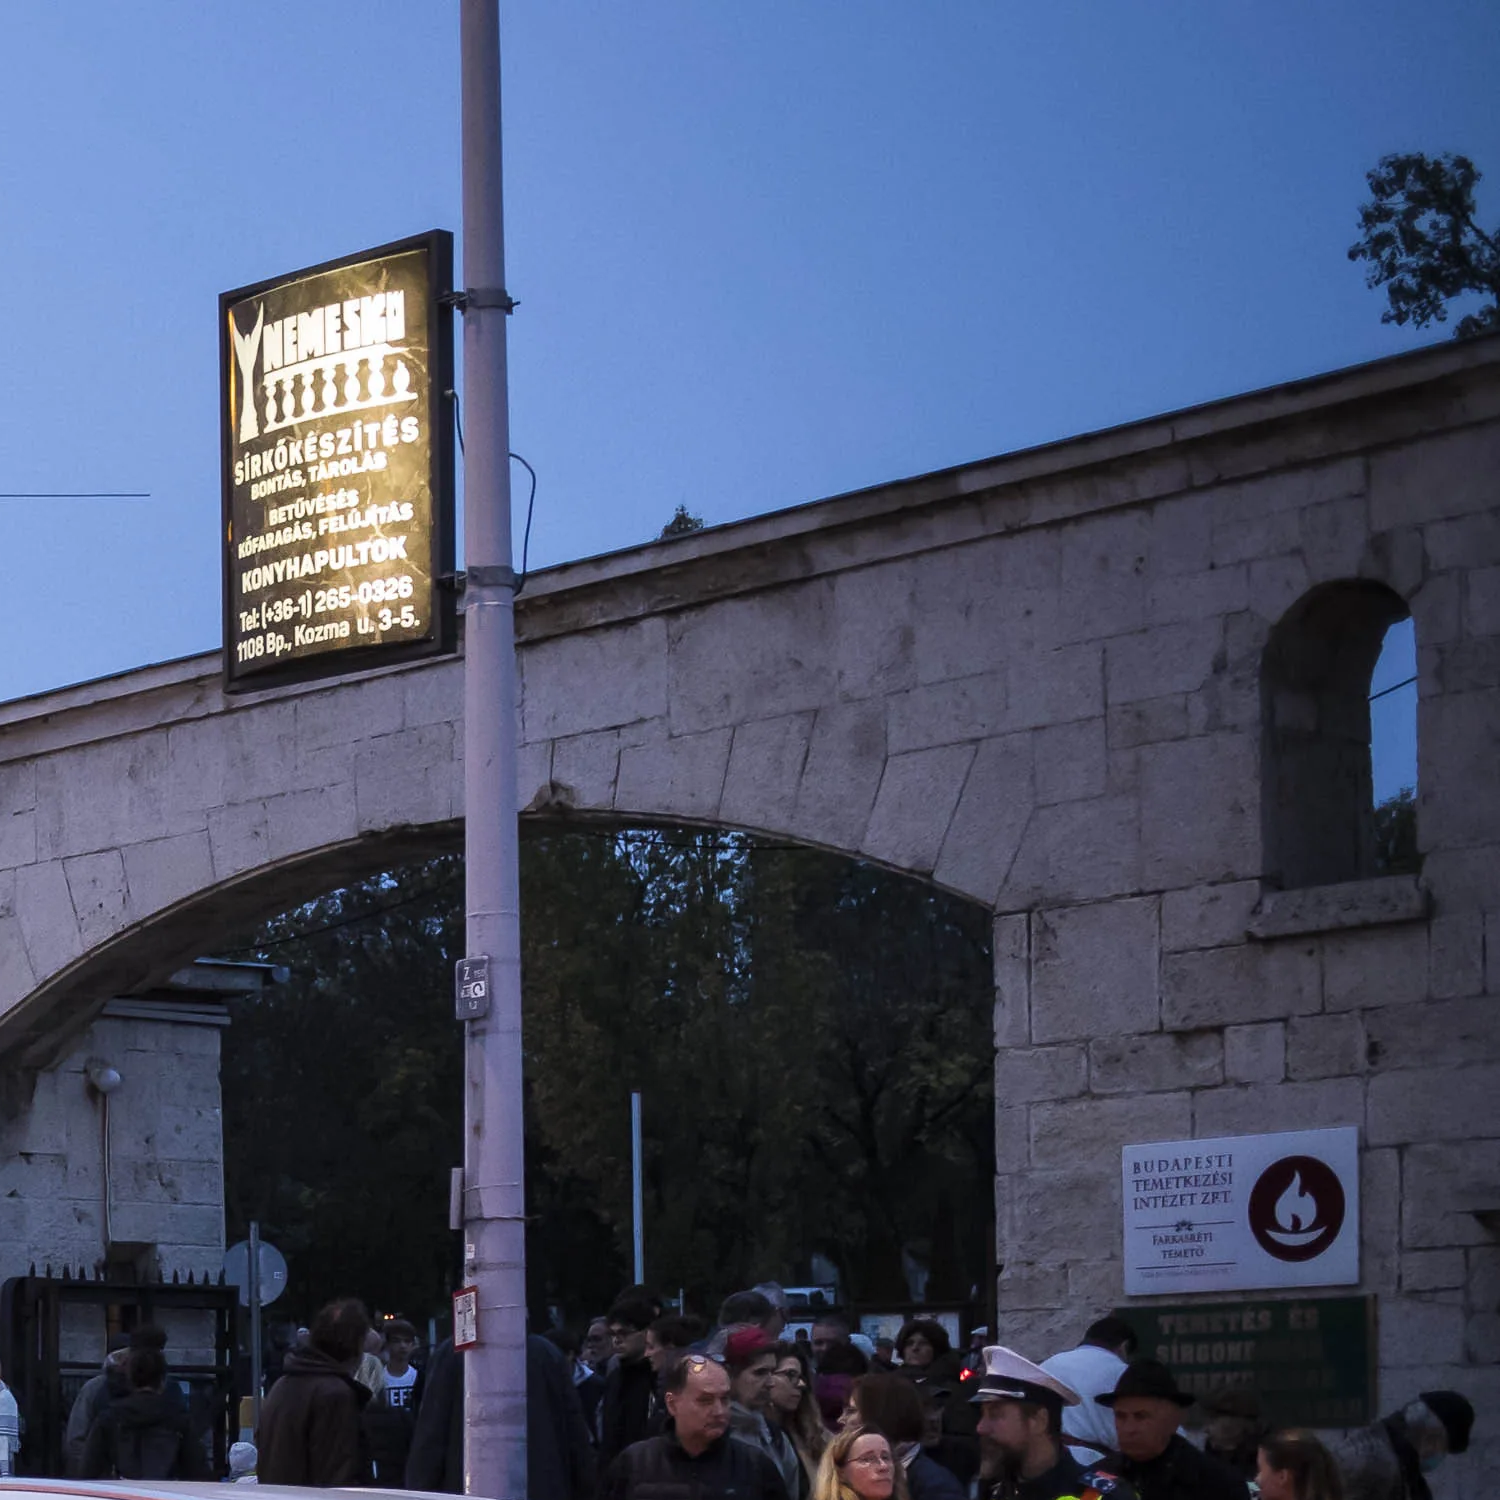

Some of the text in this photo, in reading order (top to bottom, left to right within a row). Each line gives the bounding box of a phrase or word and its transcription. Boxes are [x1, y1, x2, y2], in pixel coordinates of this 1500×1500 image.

[251, 450, 388, 500] BONTÁS, TÁROLÁS
[318, 501, 414, 536] FELÚJÍTÁS
[241, 536, 408, 594] KONYHAPULTOK
[261, 589, 313, 630] (+36-1)
[314, 575, 414, 613] 265-0326
[236, 605, 421, 663] 1108 Bp., Kozma u. 3-5.
[1132, 1171, 1233, 1193] TEMETKEZÉSI
[1133, 1154, 1233, 1175] BUDAPESTI
[1157, 1301, 1320, 1334] TEMETÉS ÉS
